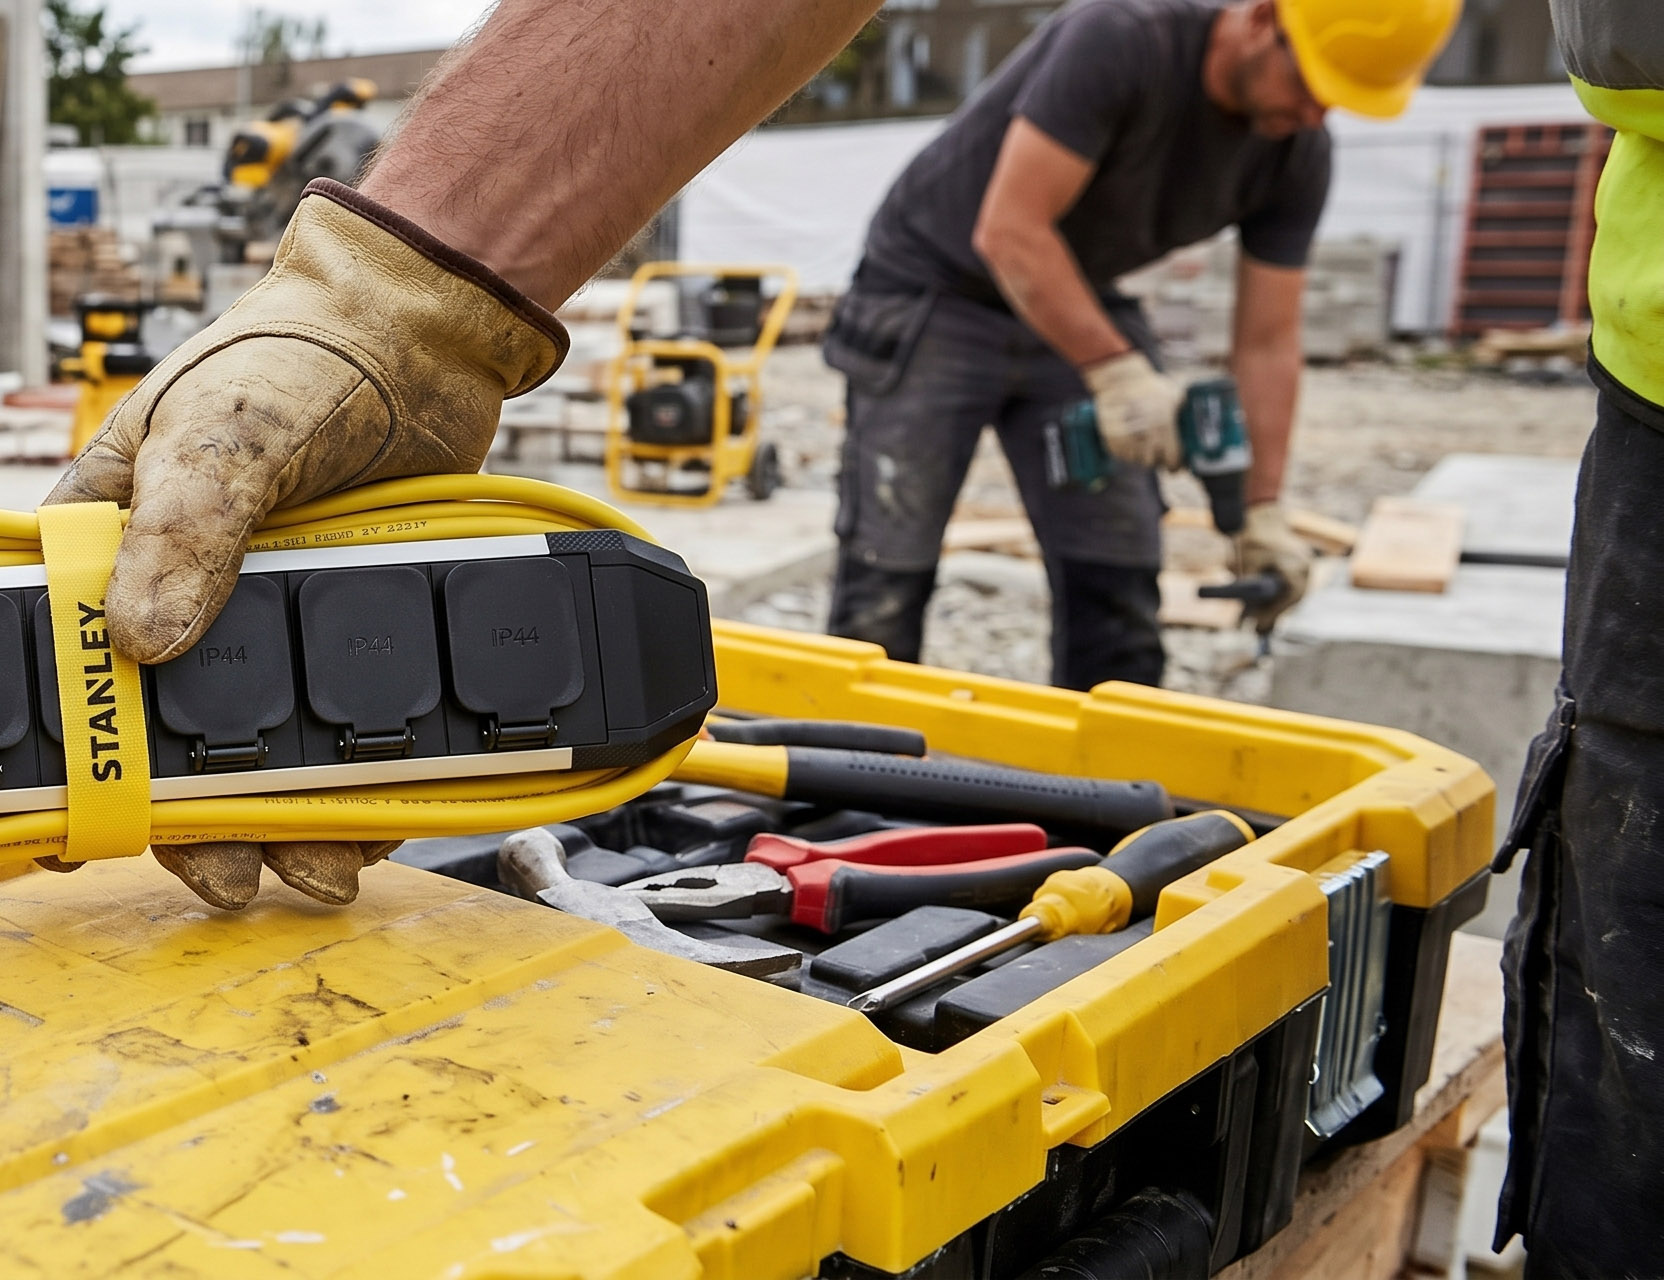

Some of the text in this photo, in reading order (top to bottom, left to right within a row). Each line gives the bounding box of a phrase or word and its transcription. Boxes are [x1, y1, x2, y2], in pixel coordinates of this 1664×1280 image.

[347, 635, 394, 656] IP44
[491, 626, 540, 648] IP44
[199, 645, 247, 667] IP44
